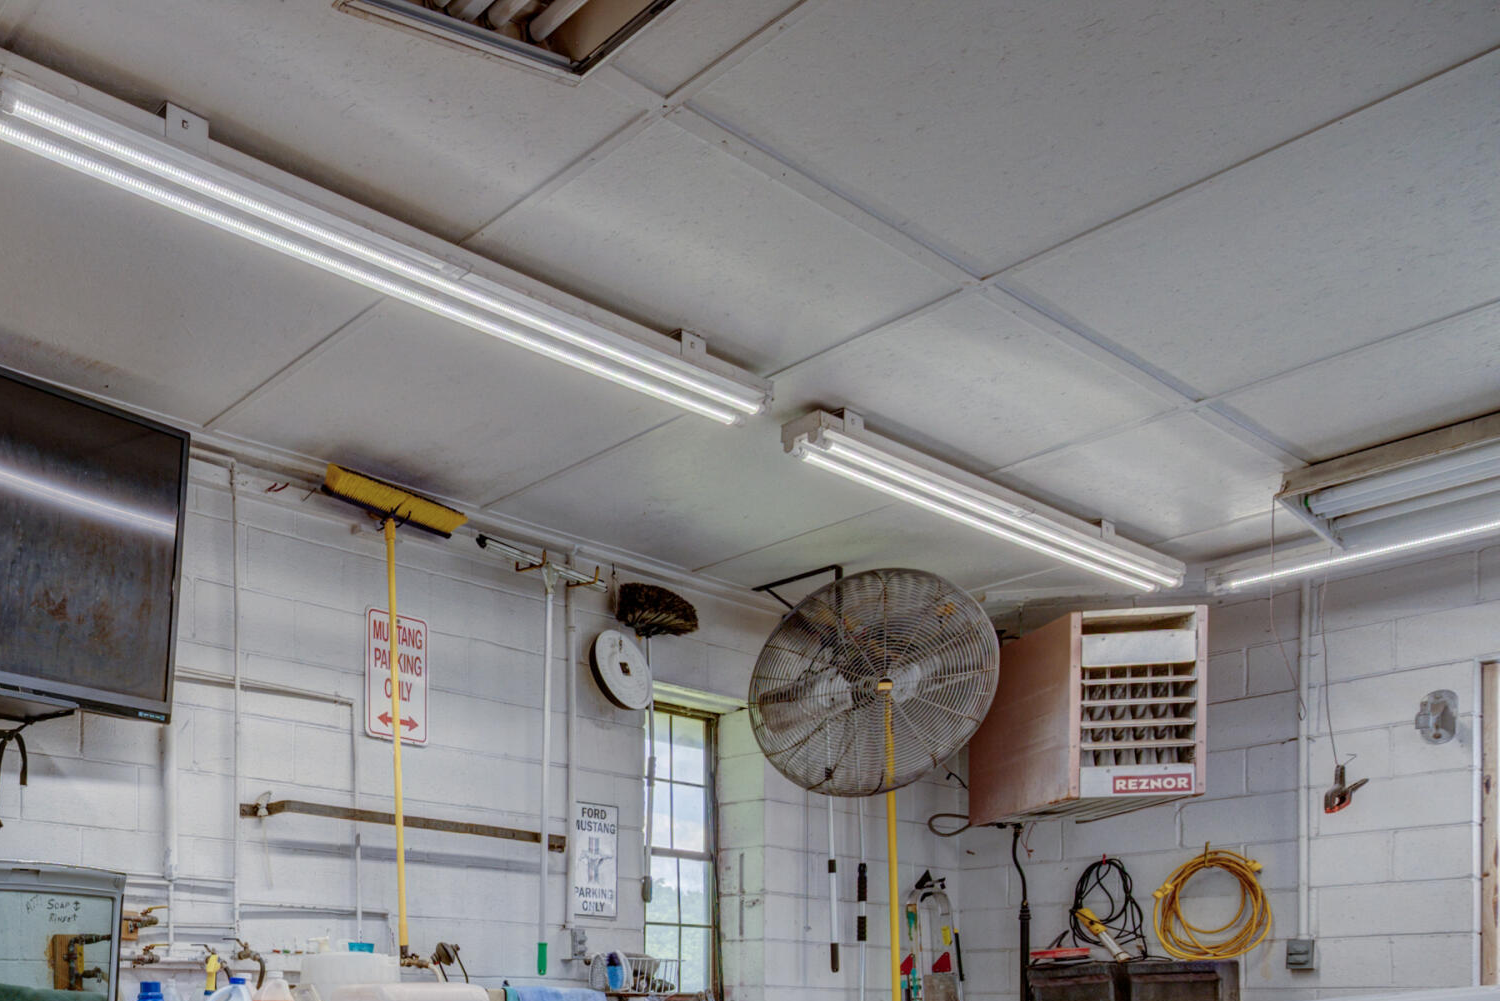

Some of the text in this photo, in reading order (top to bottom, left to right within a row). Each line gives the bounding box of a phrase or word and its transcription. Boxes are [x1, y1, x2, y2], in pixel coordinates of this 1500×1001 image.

[373, 619, 423, 650] MUTANG
[1115, 776, 1189, 791] REZNOR
[581, 807, 607, 820] FORD
[581, 900, 605, 912] ONLY
